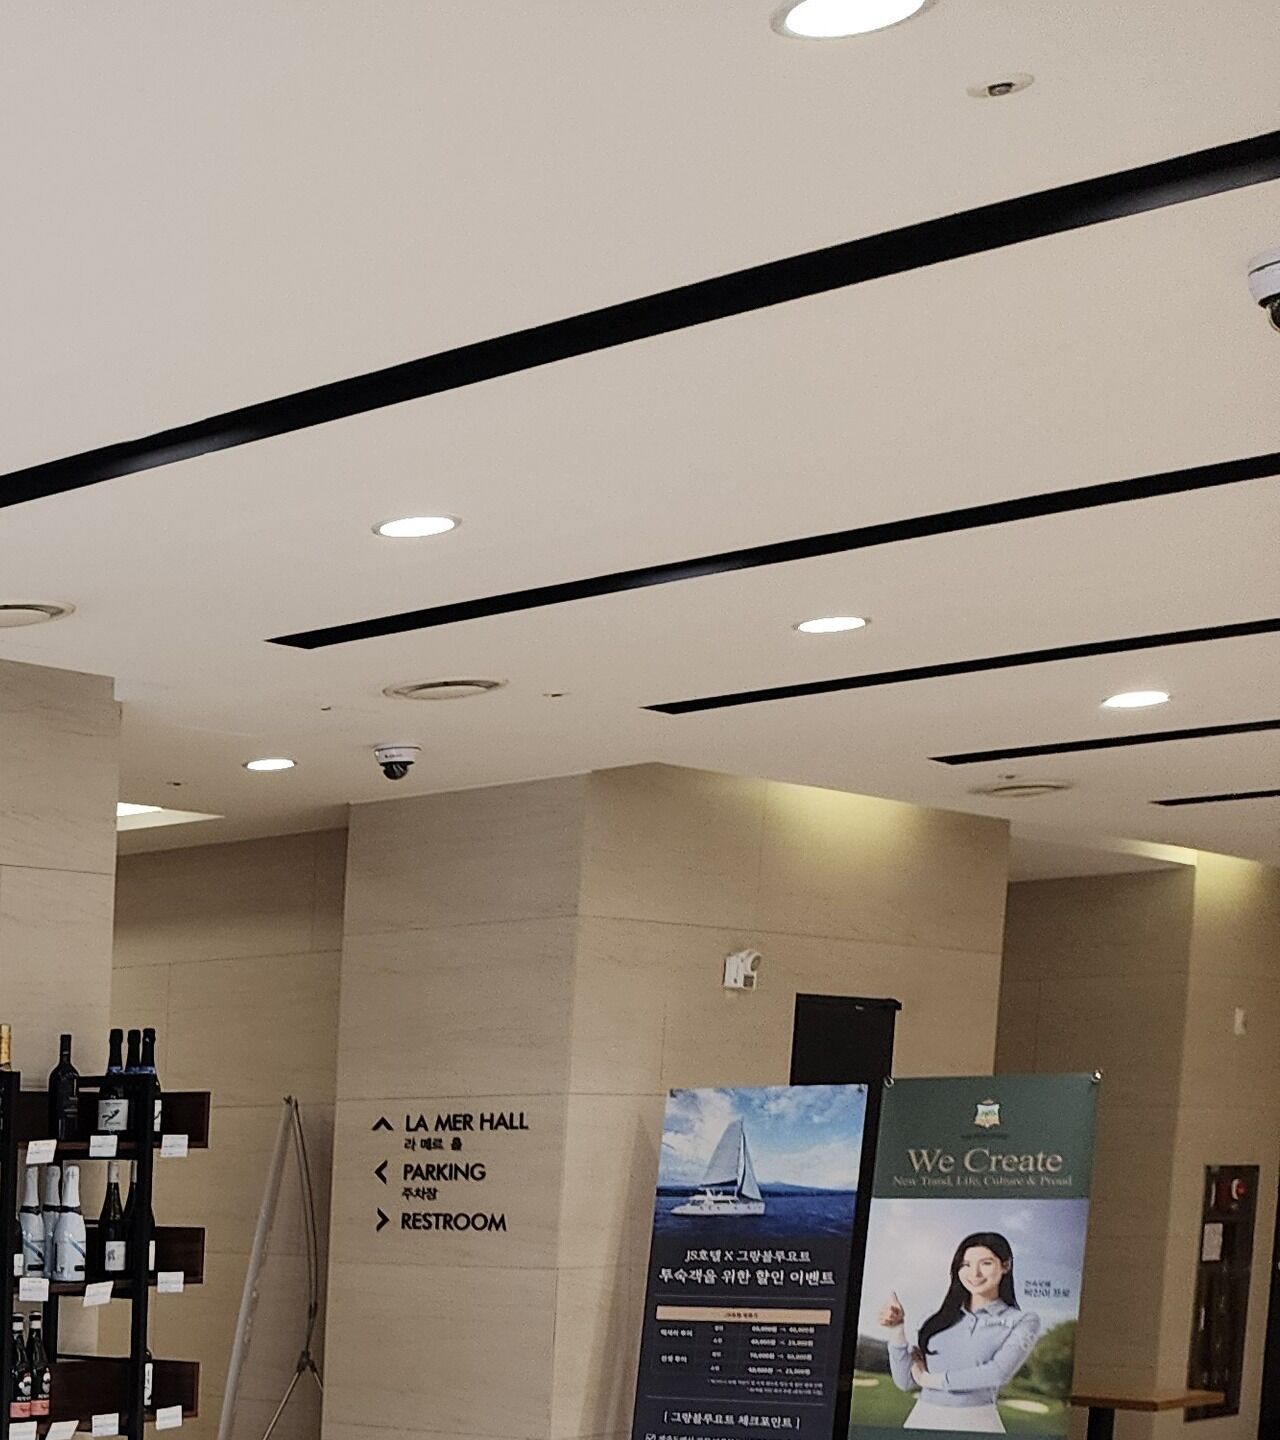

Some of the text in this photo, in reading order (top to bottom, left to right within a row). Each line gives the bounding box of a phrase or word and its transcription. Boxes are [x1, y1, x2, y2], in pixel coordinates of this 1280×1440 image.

[405, 1112, 528, 1132] LA MER HALL
[404, 1137, 418, 1151] 라
[908, 1148, 1063, 1173] We Create
[403, 1163, 486, 1181] PARKING
[402, 1187, 438, 1200] 주차장
[401, 1212, 507, 1231] RESTROOM
[658, 1268, 836, 1287] 투숙객을 위한 할인 이벤트
